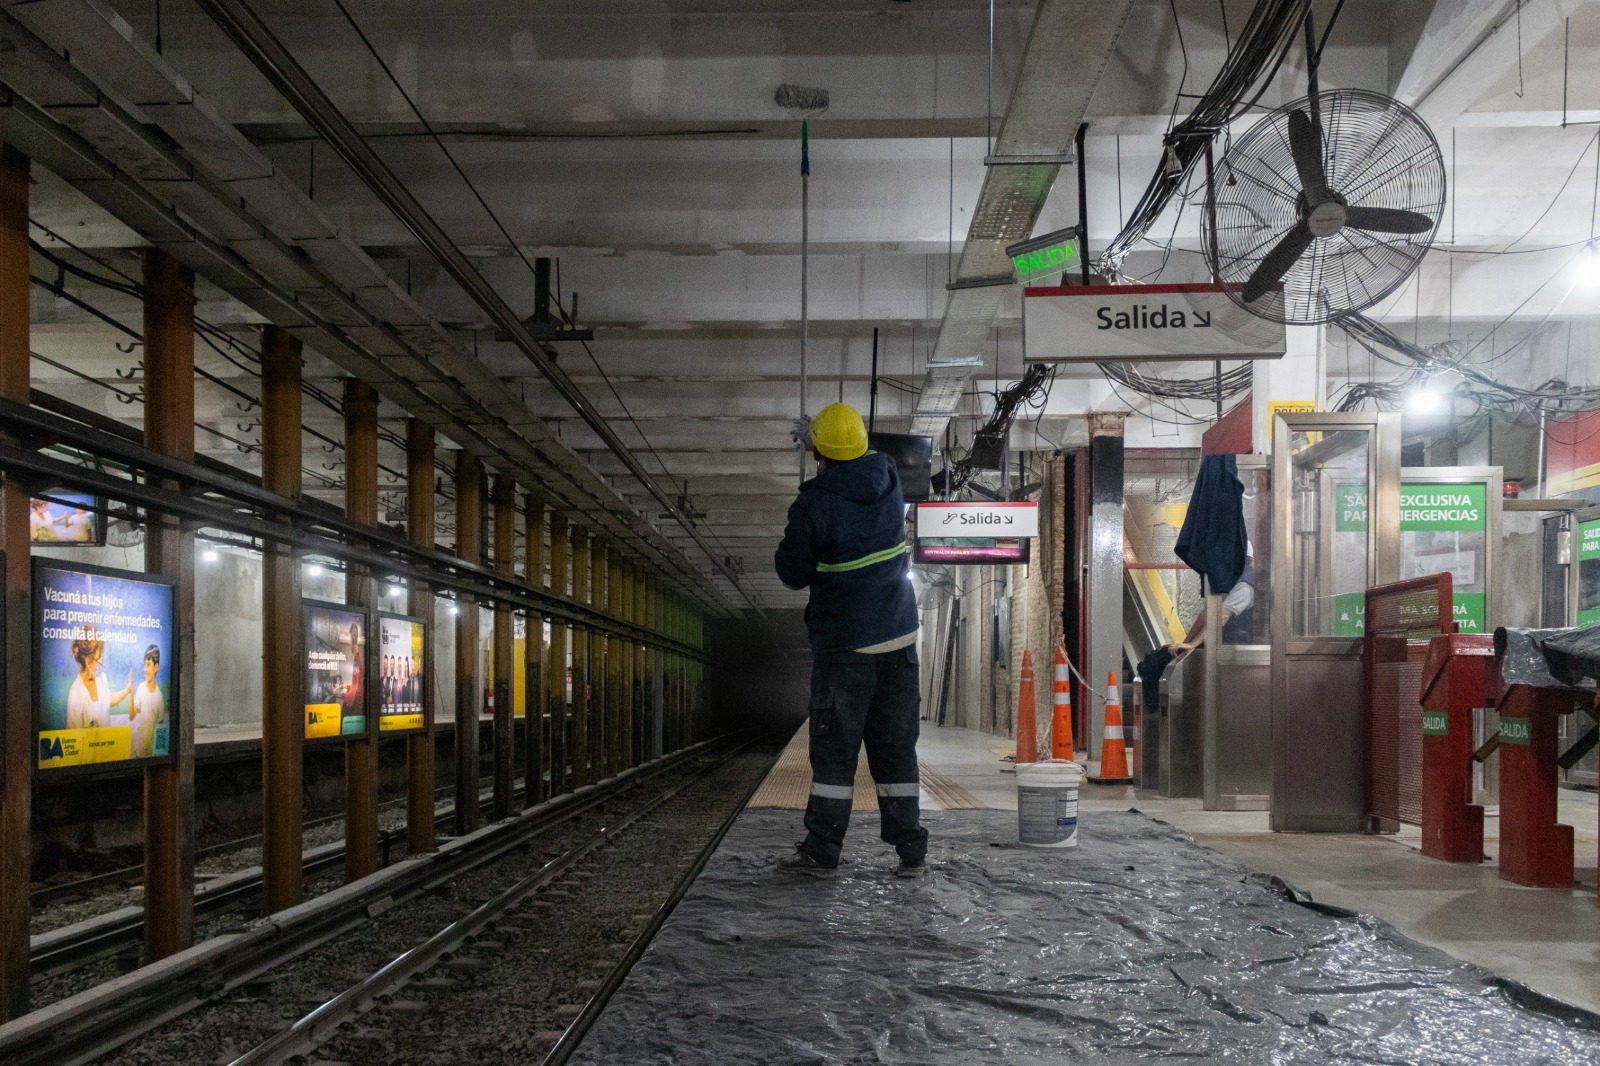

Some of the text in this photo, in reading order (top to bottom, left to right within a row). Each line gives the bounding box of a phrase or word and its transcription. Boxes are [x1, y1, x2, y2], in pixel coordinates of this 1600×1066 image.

[1016, 244, 1078, 276] SALIDA
[1097, 304, 1186, 329] Salida
[1400, 494, 1472, 506] EXCLUSIVA
[960, 512, 1001, 525] Salida
[44, 587, 80, 603] Vacuná
[88, 592, 101, 606] tus
[102, 594, 123, 610] hijos
[43, 608, 162, 630] para prevenir enfermedades,
[42, 625, 137, 643] consultá el calendario
[1422, 716, 1446, 730] SALIDA
[1499, 722, 1528, 738] SALIDA
[40, 737, 64, 760] BA
